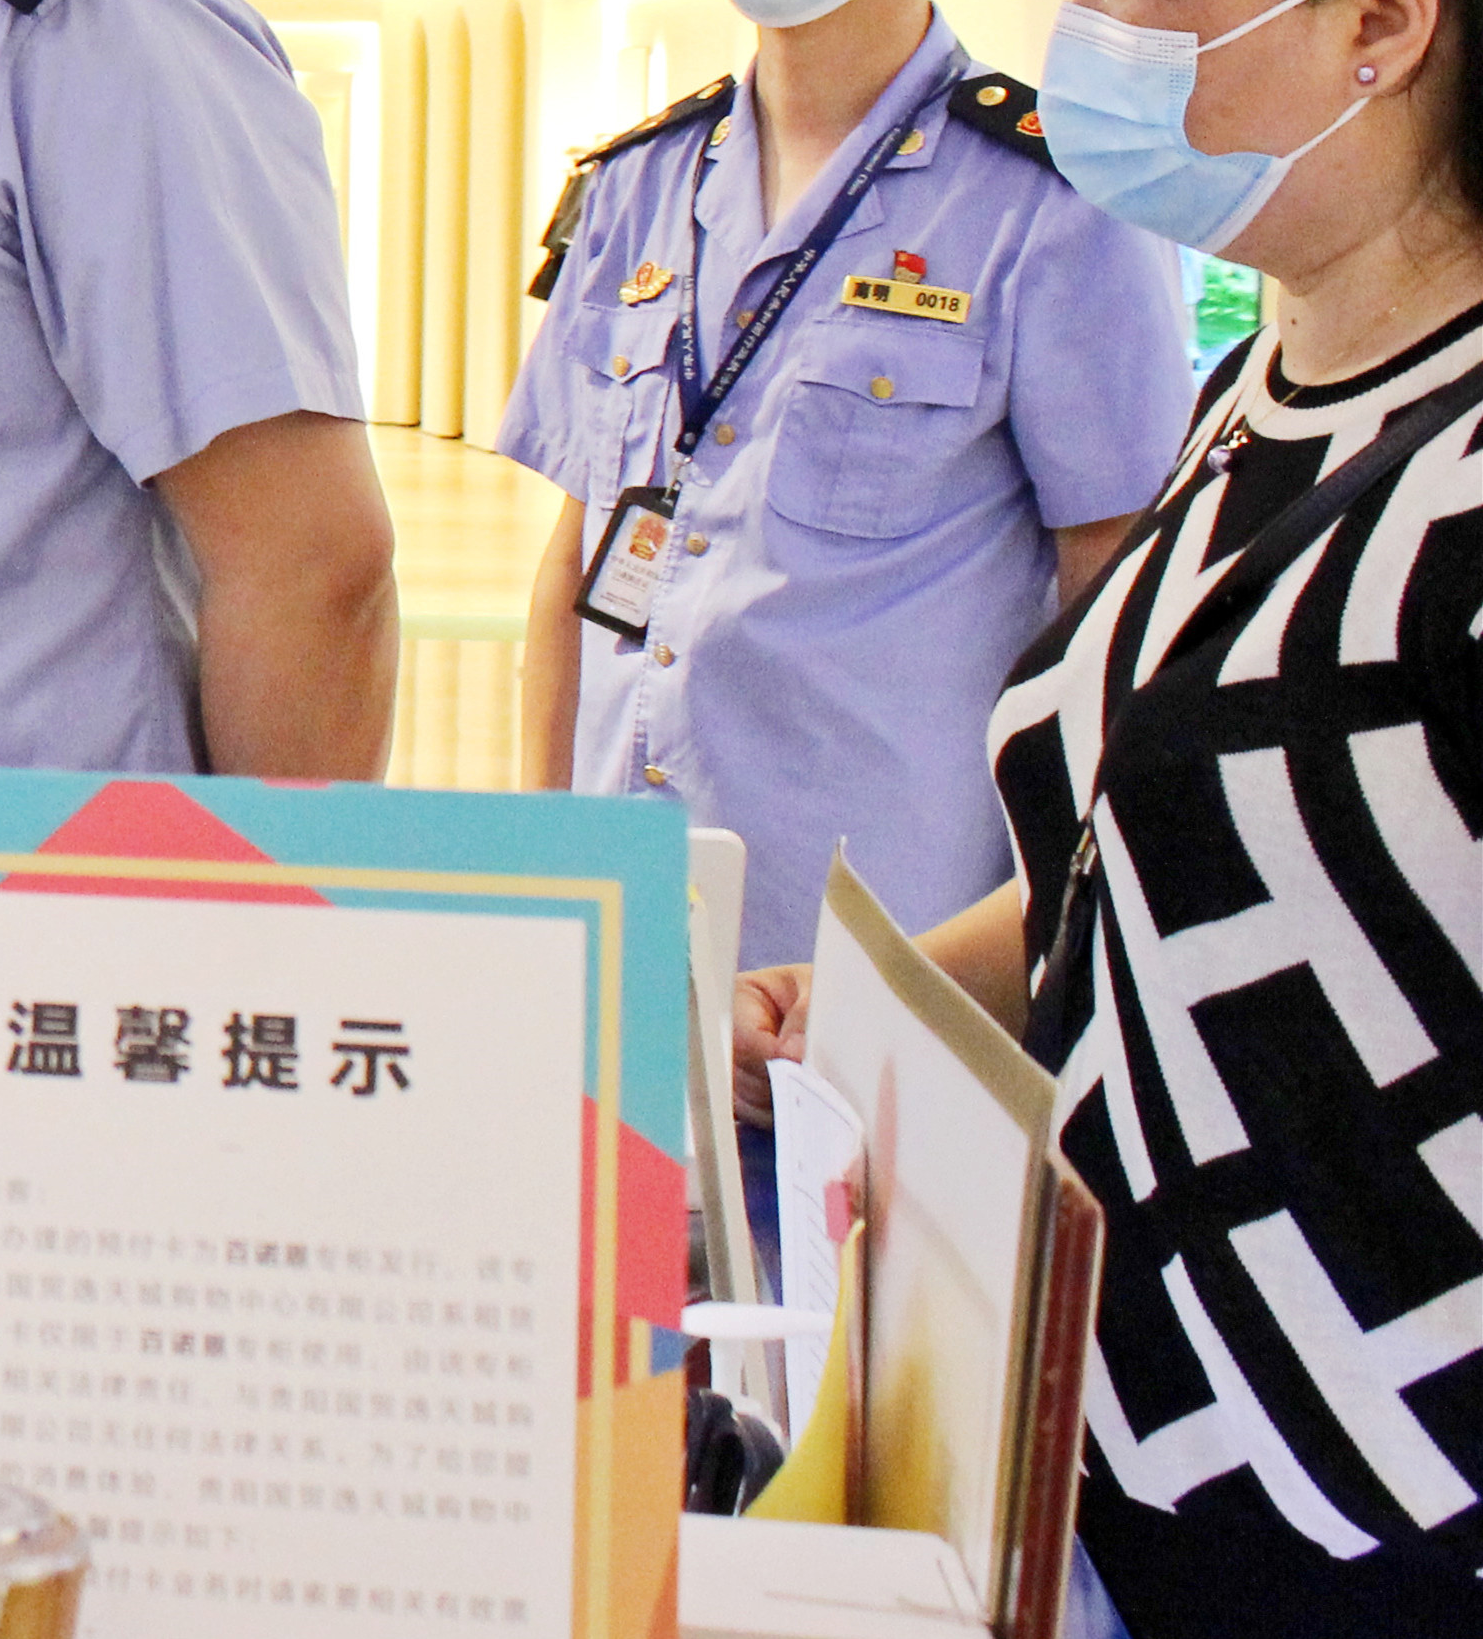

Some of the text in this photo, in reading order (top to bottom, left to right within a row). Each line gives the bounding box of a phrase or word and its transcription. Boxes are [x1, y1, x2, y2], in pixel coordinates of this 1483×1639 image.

[915, 291, 960, 312] 0018
[6, 1000, 412, 1097] 温馨提示
